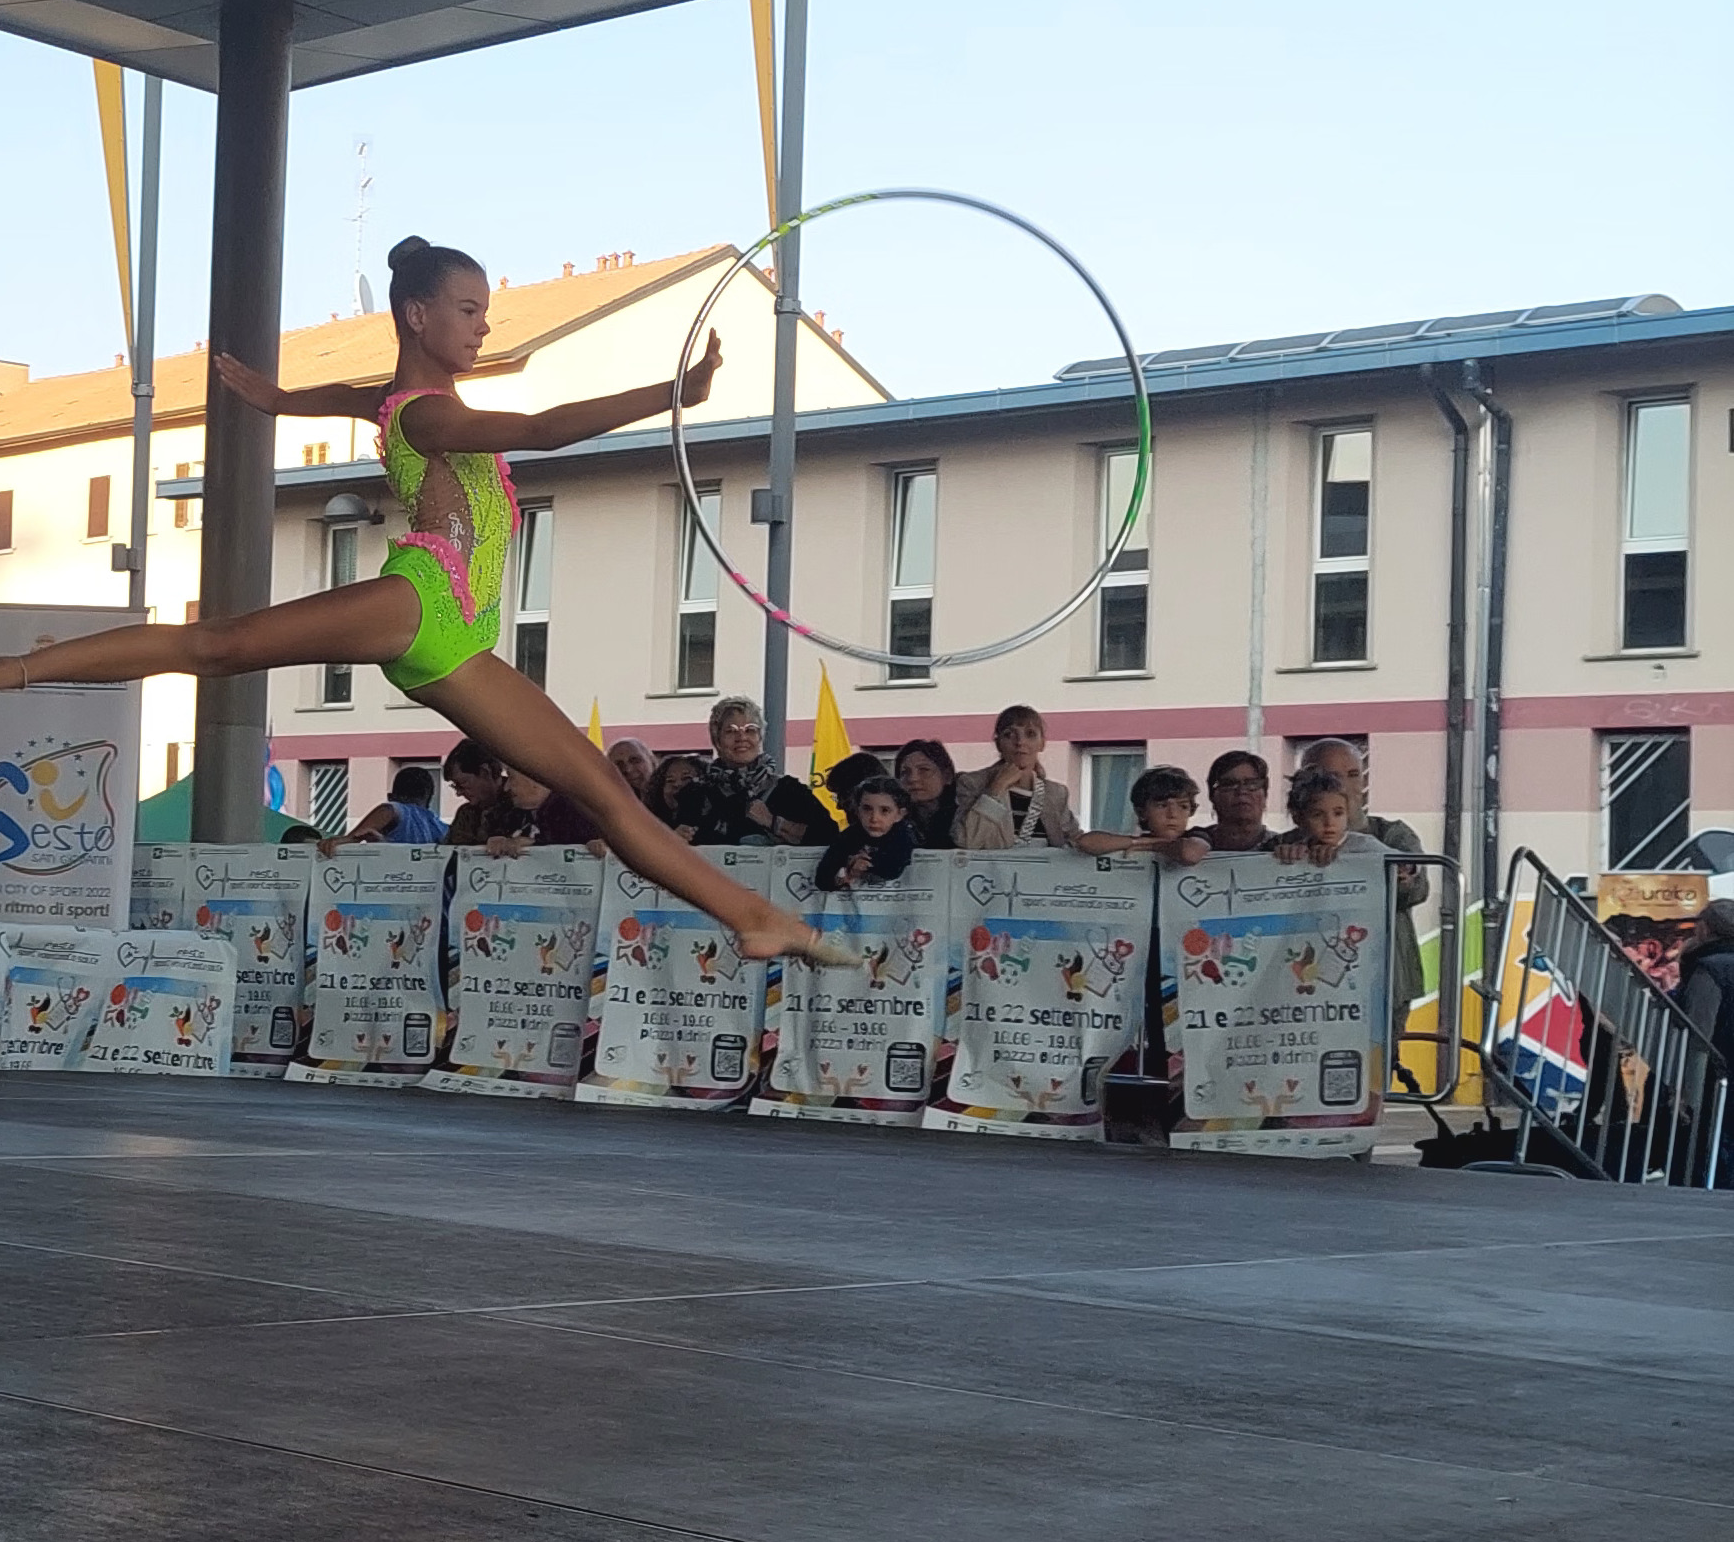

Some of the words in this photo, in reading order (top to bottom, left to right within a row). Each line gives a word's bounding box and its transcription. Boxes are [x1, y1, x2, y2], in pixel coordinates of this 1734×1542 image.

[5, 884, 28, 895] CITY
[30, 885, 46, 896] OF
[49, 886, 84, 897] SPORT
[86, 887, 111, 898] 2022
[5, 901, 46, 915] ritmo
[49, 902, 64, 915] di
[67, 903, 110, 919] sport!
[319, 973, 335, 989] 21
[339, 975, 348, 989] e
[463, 975, 480, 993] 21
[484, 979, 492, 993] e
[514, 981, 583, 1000] settembre
[609, 984, 631, 1004] 21
[636, 989, 646, 1004] e
[669, 990, 748, 1010] settembre
[785, 994, 803, 1012] 21
[808, 995, 814, 1012] e
[836, 996, 925, 1017] settembre
[965, 1002, 982, 1022] 21
[986, 1005, 996, 1022] e
[1029, 1006, 1123, 1031] settembre
[1185, 1009, 1211, 1029] 21
[1216, 1011, 1228, 1028] e
[1259, 1000, 1361, 1026] settembre
[89, 1045, 108, 1059] 21
[111, 1047, 119, 1061] e
[143, 1048, 215, 1070] settembre
